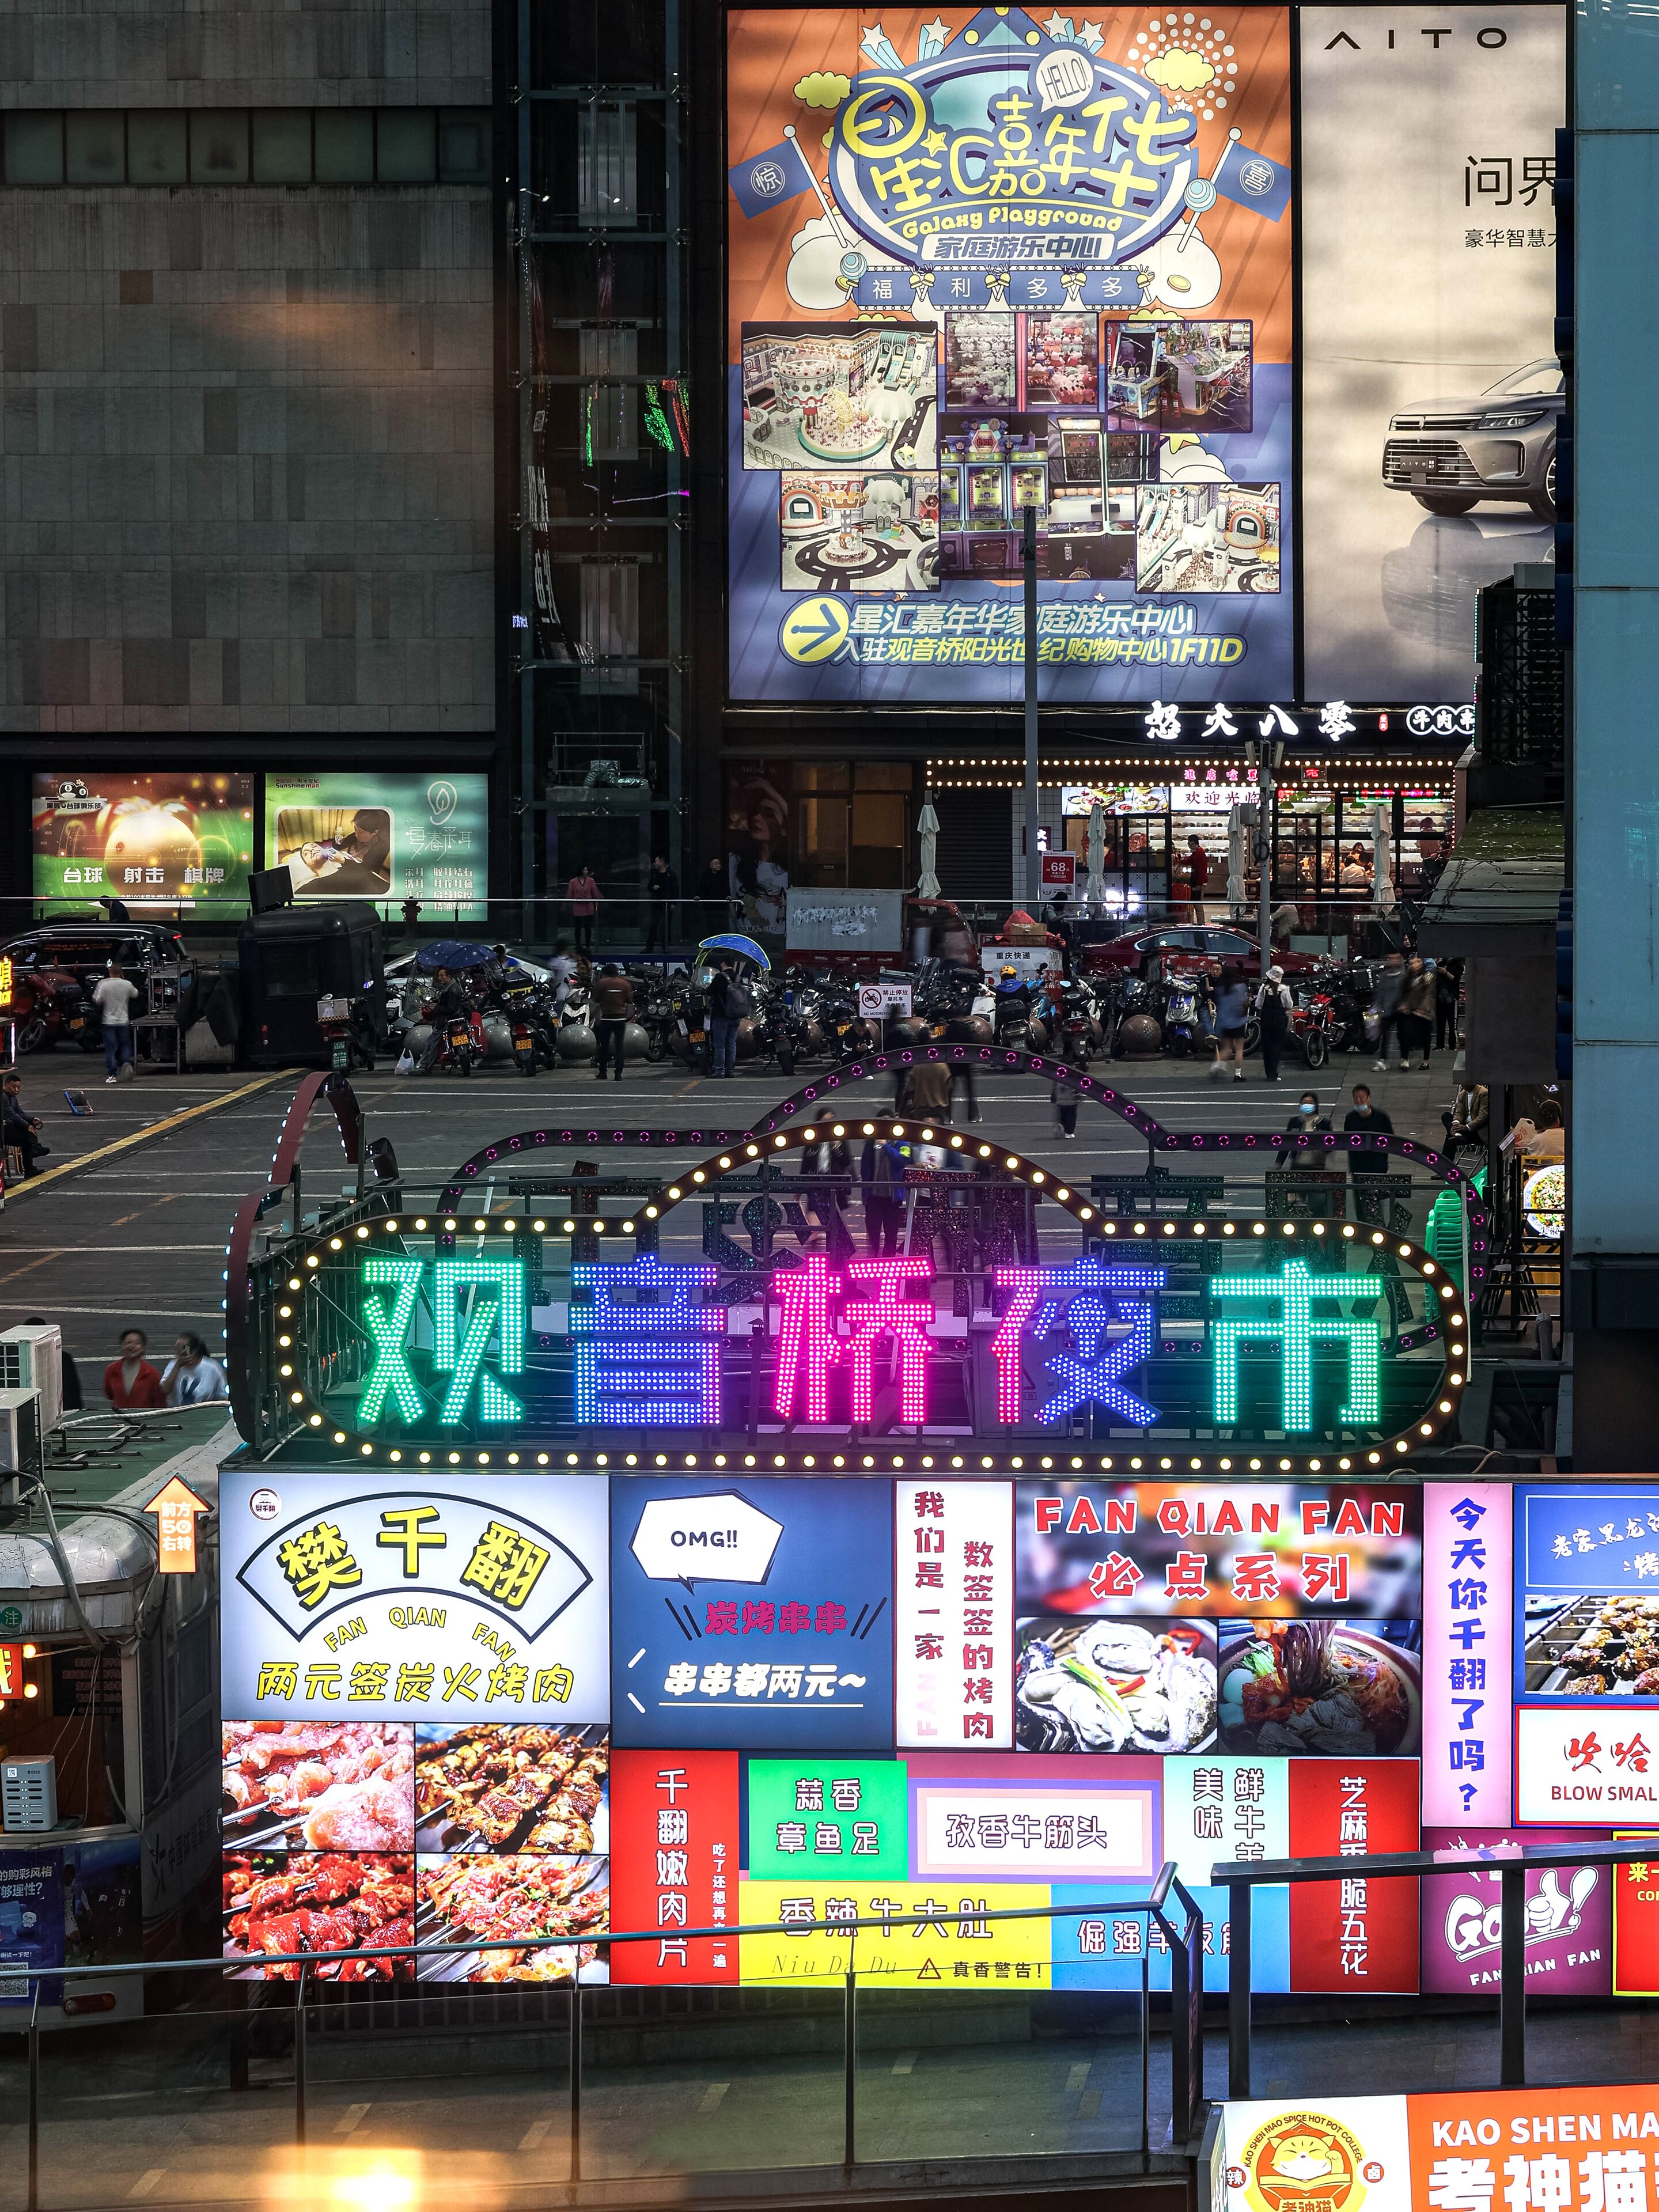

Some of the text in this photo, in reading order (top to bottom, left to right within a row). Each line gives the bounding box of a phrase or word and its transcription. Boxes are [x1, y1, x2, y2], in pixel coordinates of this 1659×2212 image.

[1042, 58, 1091, 104] HELLO!
[842, 74, 1191, 213] 星汇嘉年华
[754, 165, 783, 192] 惊
[1245, 163, 1271, 191] 喜
[1465, 155, 1555, 207] 问界
[902, 205, 1123, 240] Galaxy Playground
[934, 235, 1102, 260] 家庭游乐中心
[872, 276, 1123, 300] 福利多多
[849, 603, 1193, 636] 星汇嘉年华家庭游乐中心
[1184, 790, 1260, 806] 欢迎光临
[63, 867, 224, 884] 台球 射击 棋牌
[1051, 862, 1066, 872] 68
[354, 1252, 1384, 1433] 观音桥夜市
[161, 1501, 192, 1518] 前方
[1033, 1495, 1405, 1539] FAN QIAN FAN
[161, 1537, 192, 1552] 右转
[670, 1530, 738, 1549] OMG!!
[276, 1505, 551, 1612] 樊千翻
[914, 1490, 945, 1660] 我们是一家
[1088, 1551, 1351, 1602] 必点系列
[325, 1606, 516, 1662] FAN QIAN FAN
[704, 1600, 849, 1635] 炭烤串串
[963, 1540, 994, 1740] 数签签的烤肉
[1448, 1497, 1488, 1812] 今天你千翻了吗？
[256, 1661, 574, 1703] 两元签炭火烤肉
[916, 1673, 938, 1736] FAN
[794, 1777, 863, 1812] 蒜香
[1193, 1768, 1224, 1839] 美味
[1551, 1786, 1658, 1802] BLOW SMAL
[775, 1820, 880, 1855] 章鱼足
[945, 1813, 1107, 1849] 孜香牛筋头
[0, 1866, 52, 1881] 的购彩风格
[656, 1768, 688, 1967] 千翻嫩肉片
[711, 1843, 727, 1968] 吃了还想再一遍
[779, 1897, 993, 1939] 香辣牛大肚
[1077, 1919, 1230, 1955] 倔强羊
[771, 1955, 816, 1975] Niu
[869, 1956, 897, 1975] Du
[1524, 1959, 1556, 1977] IAN
[1566, 1949, 1601, 1967] FAN
[1244, 2114, 1363, 2168] KAO SHEN MAO SPICE HOT POT COLLEGE
[1433, 2111, 1659, 2147] KAO SHEN MA
[1227, 2169, 1244, 2186] 辣
[1366, 2164, 1381, 2180] 卤
[1428, 2149, 1659, 2212] 考神猫
